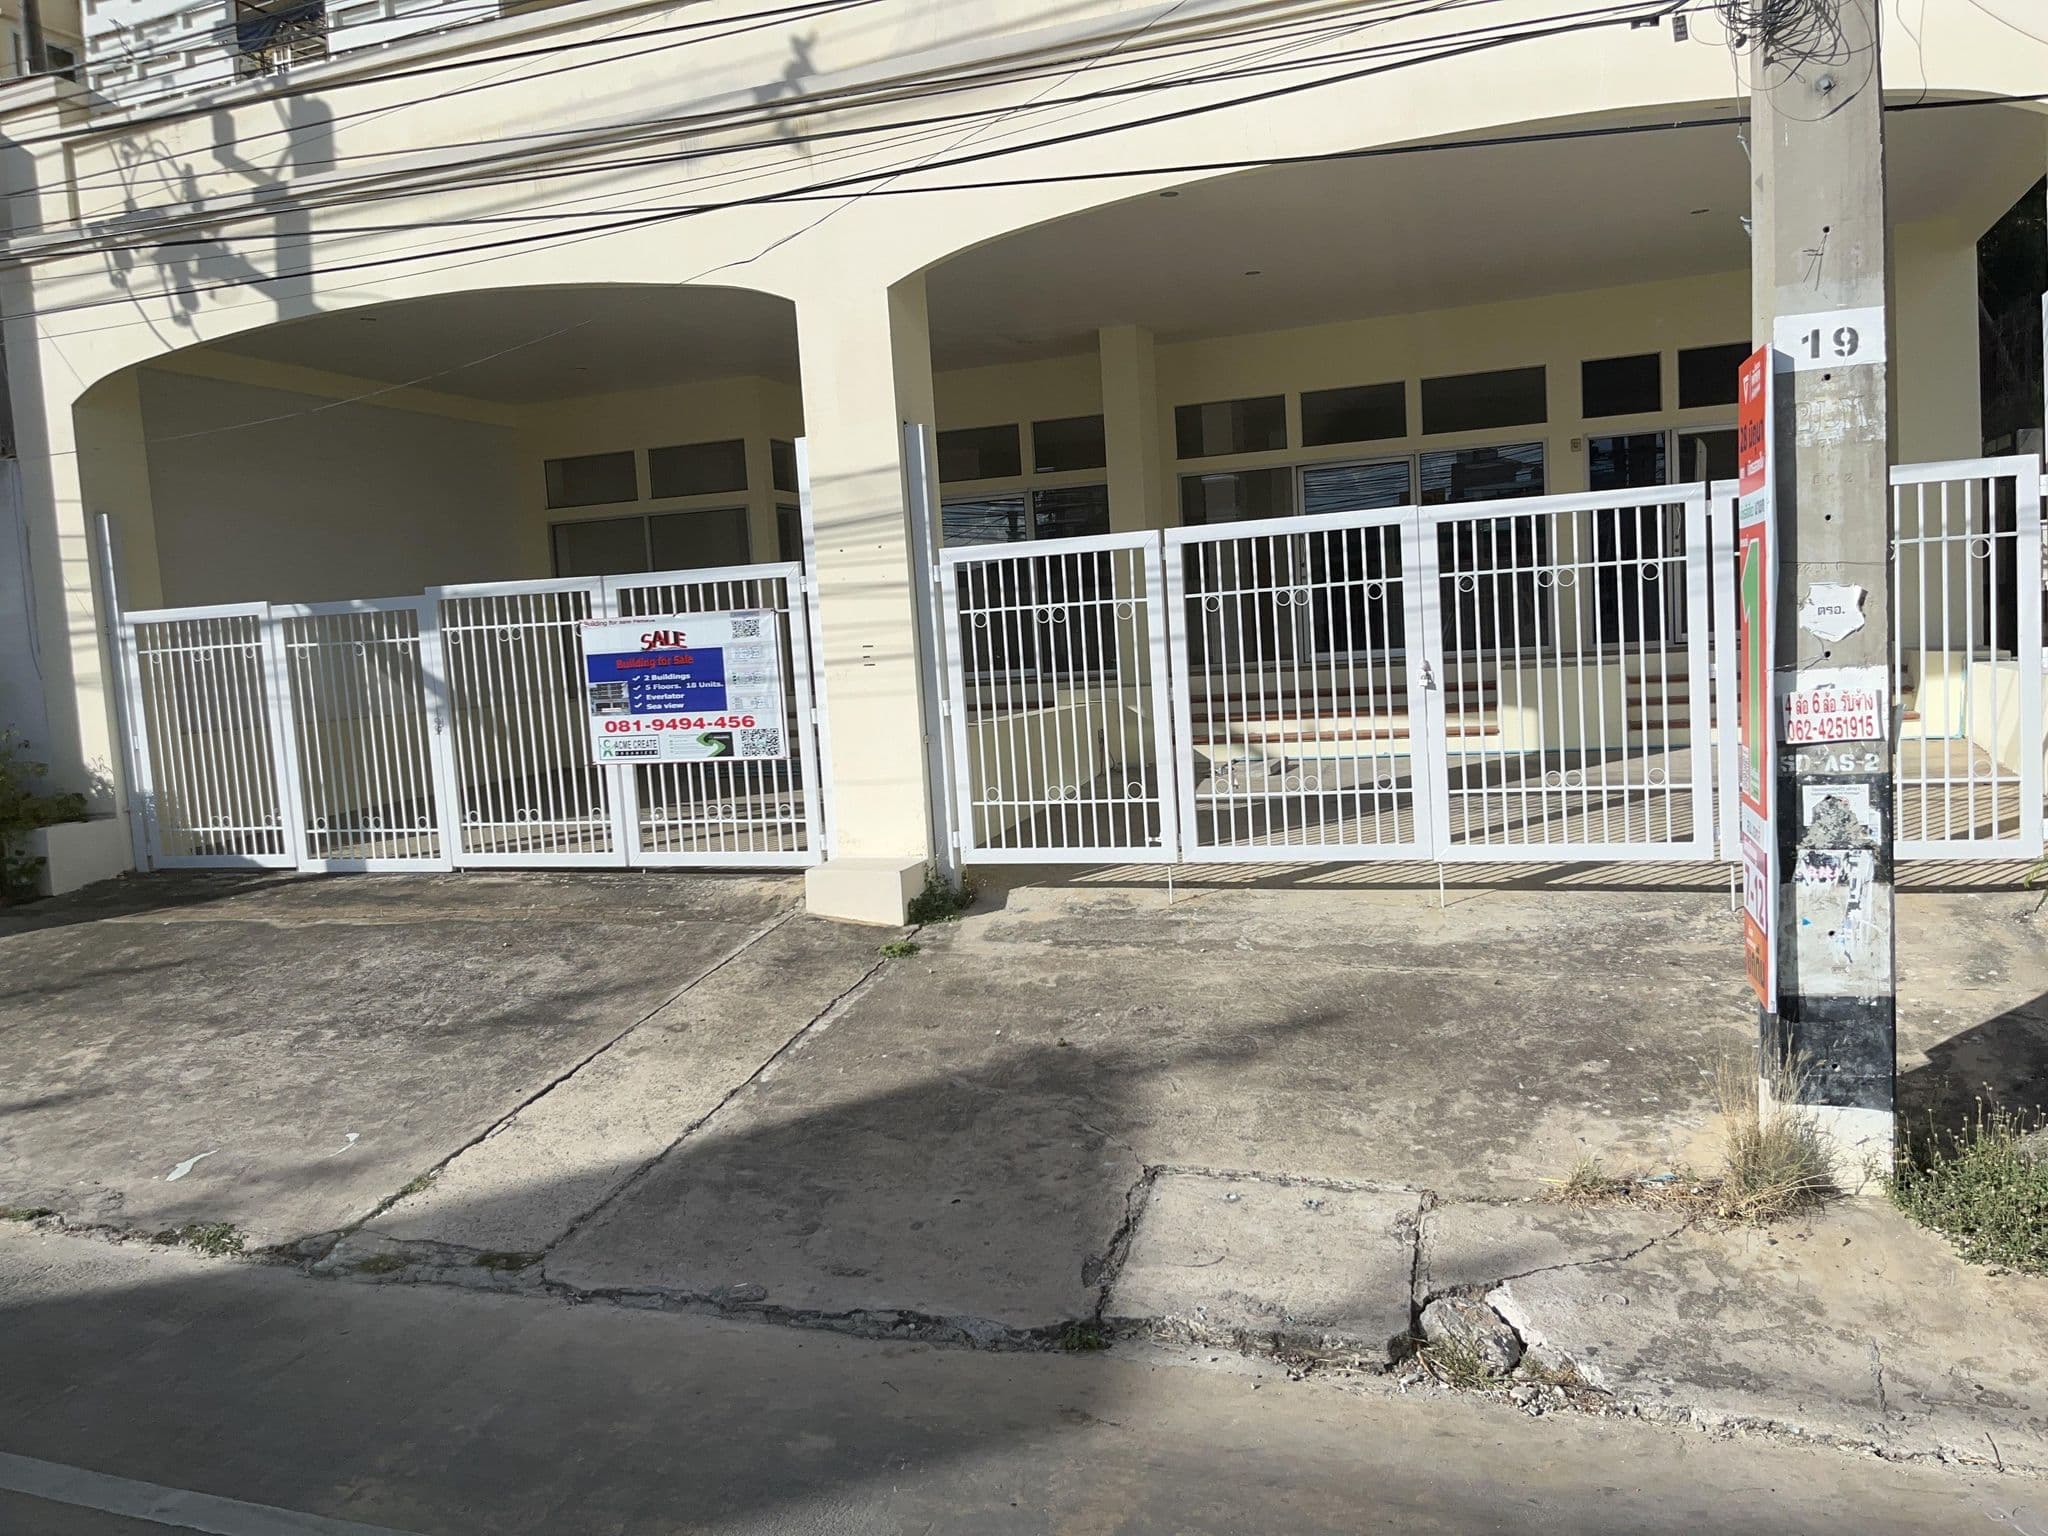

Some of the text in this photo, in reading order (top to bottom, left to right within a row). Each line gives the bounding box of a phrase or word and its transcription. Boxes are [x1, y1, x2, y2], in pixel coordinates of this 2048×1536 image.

[1801, 327, 1859, 359] 19
[1816, 603, 1847, 616] ตรอ.
[641, 629, 688, 651] SALE
[616, 654, 694, 669] Building for Sale
[651, 673, 690, 682] Buildings
[646, 693, 685, 701] Everlator
[1796, 691, 1809, 715] ล้อ
[1812, 692, 1820, 713] 6
[1823, 690, 1836, 713] ล้อ
[1840, 688, 1874, 712] รับจ้าง
[604, 714, 756, 733] 081-9494-456
[1787, 715, 1874, 741] 062-4251915
[615, 740, 632, 749] ACME
[633, 739, 657, 749] CREATE
